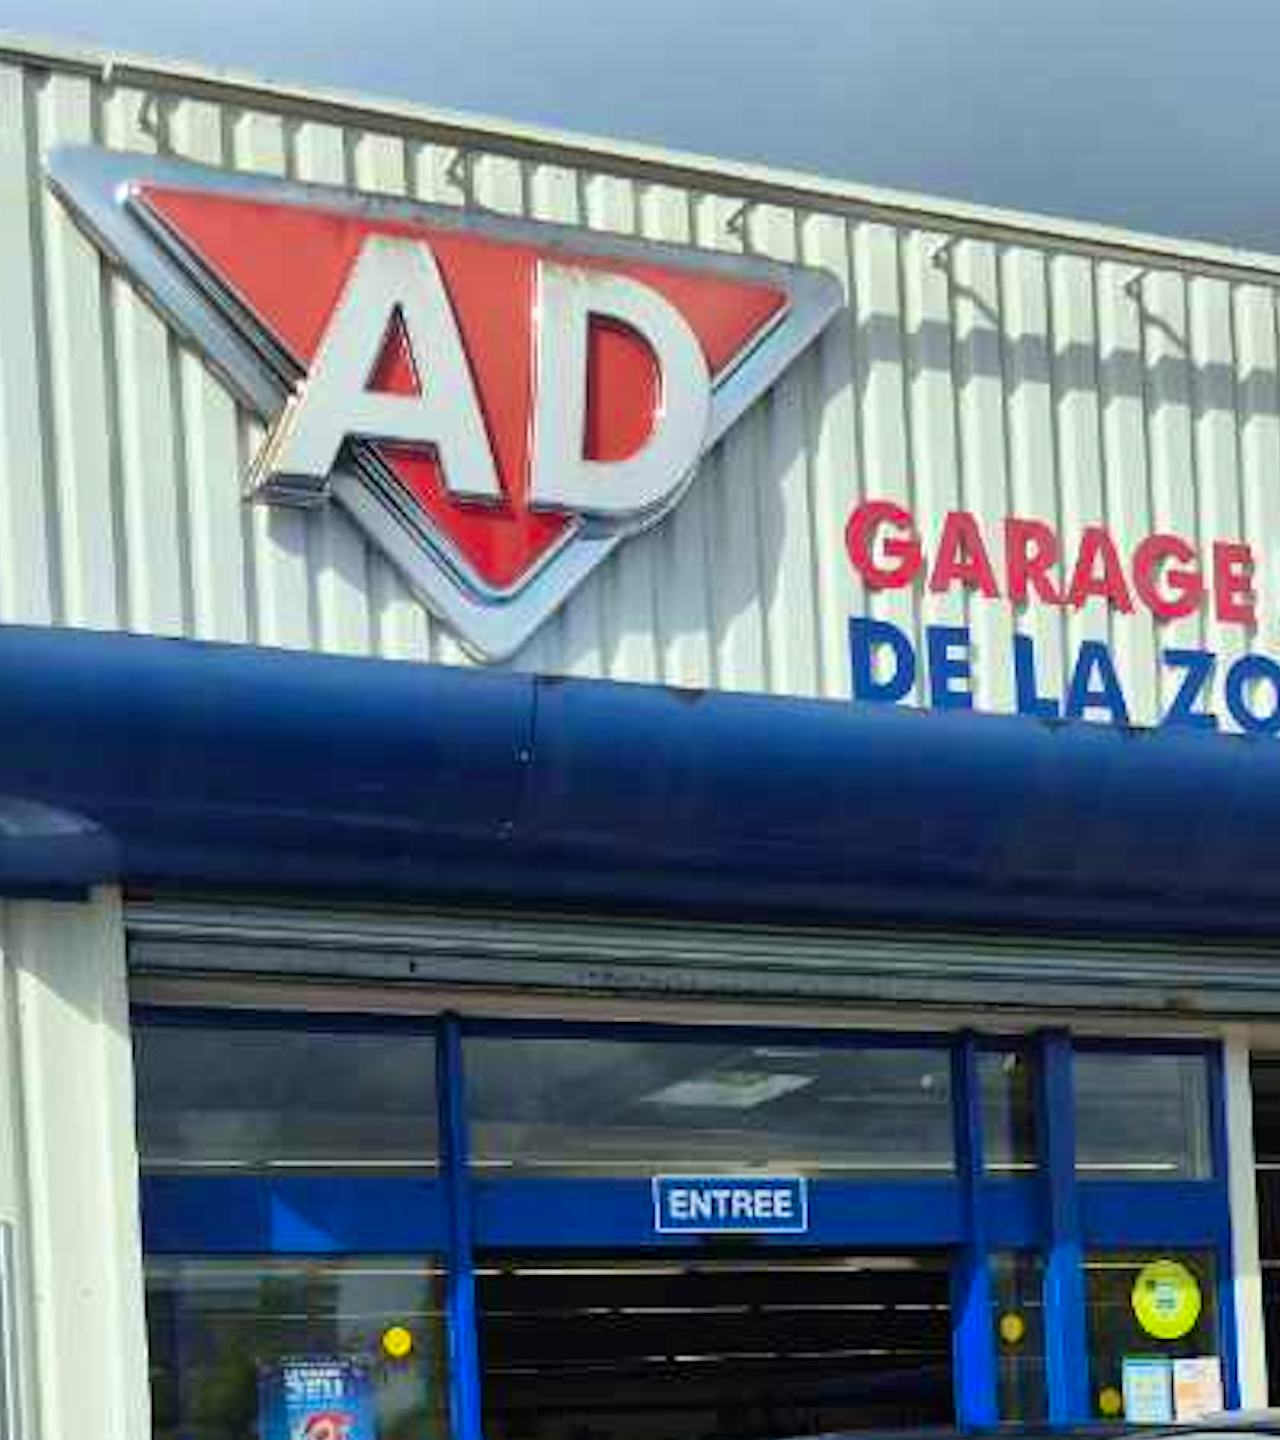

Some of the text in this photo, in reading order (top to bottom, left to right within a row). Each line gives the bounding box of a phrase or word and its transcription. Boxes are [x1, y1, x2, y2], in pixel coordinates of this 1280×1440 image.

[246, 232, 715, 524] AD
[845, 499, 1258, 626] GARAGE
[847, 616, 973, 710] DE
[1014, 633, 1131, 728] LA
[669, 1189, 794, 1218] ENTREE
